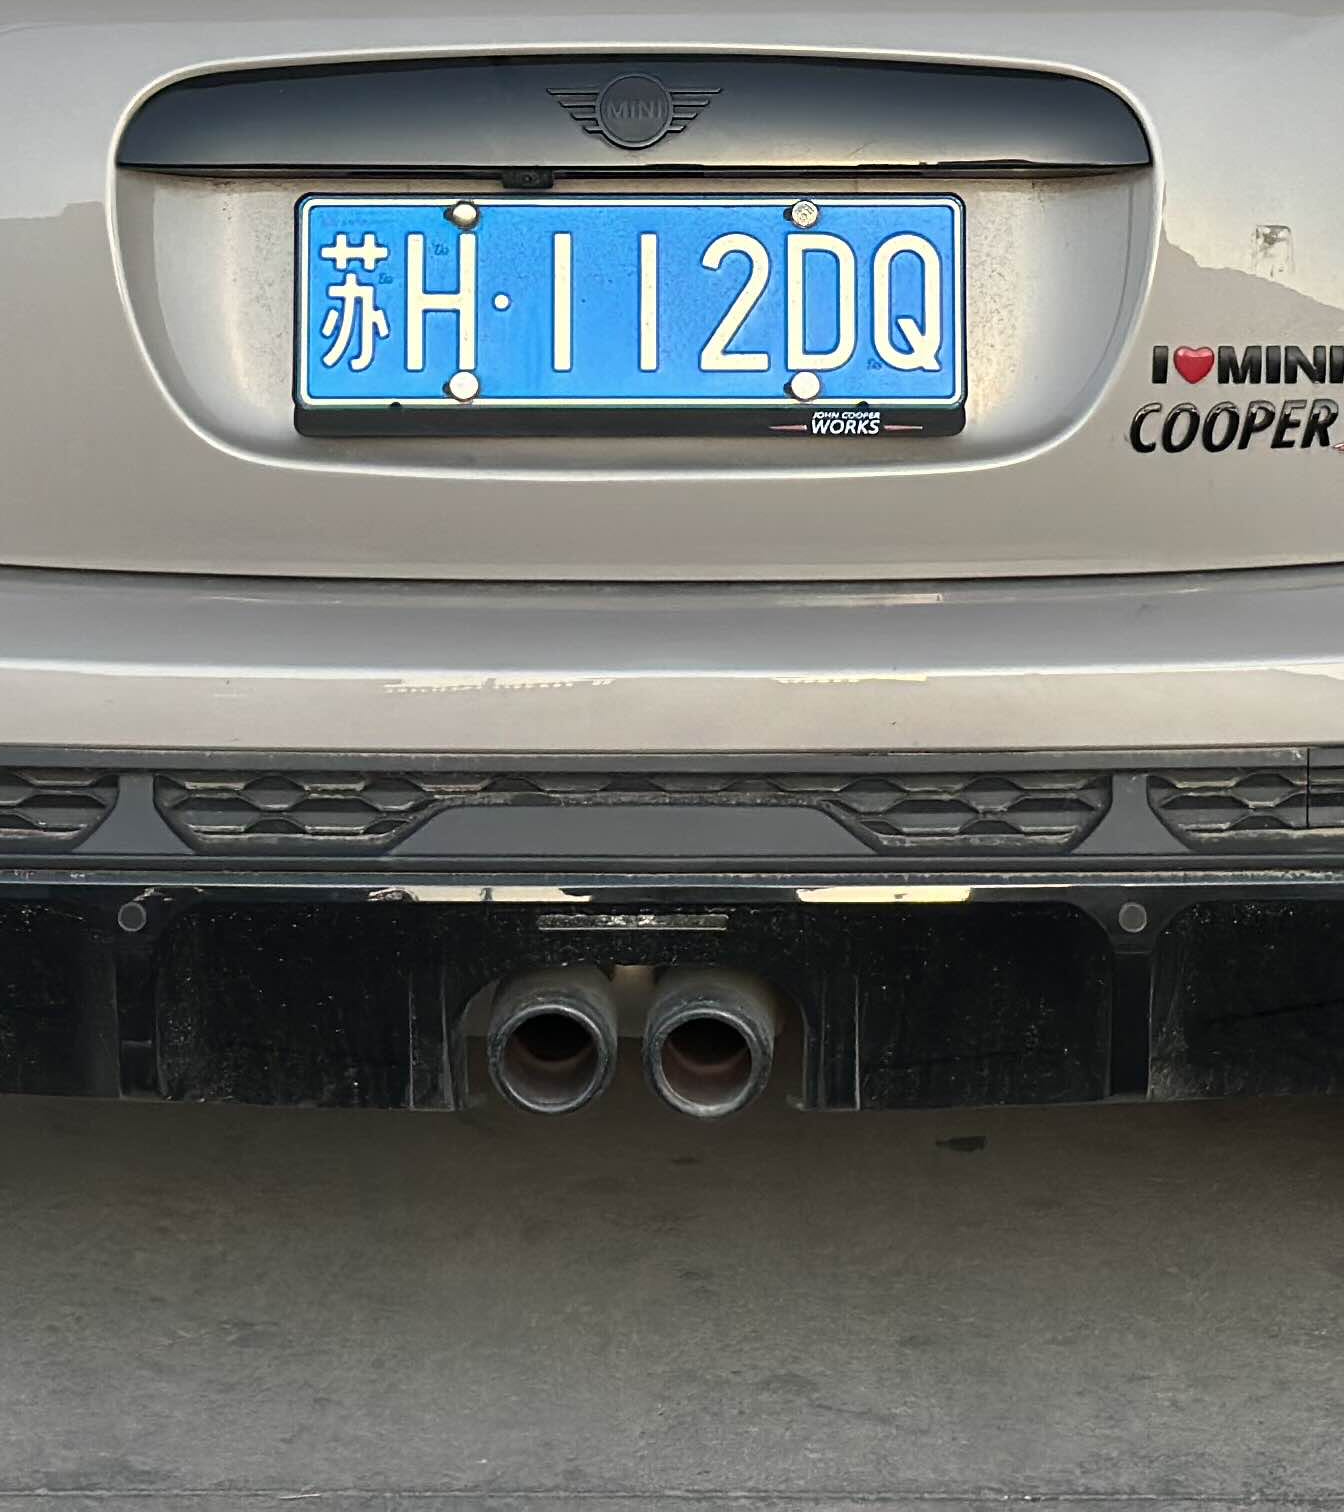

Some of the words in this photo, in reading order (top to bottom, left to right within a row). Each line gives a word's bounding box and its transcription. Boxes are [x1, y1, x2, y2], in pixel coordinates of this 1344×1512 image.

[608, 101, 663, 121] MINI
[1217, 345, 1344, 384] MINI
[813, 411, 840, 420] JOHN
[841, 411, 881, 420] COOPER
[1130, 398, 1339, 453] COOPER
[811, 419, 881, 435] WORKS
